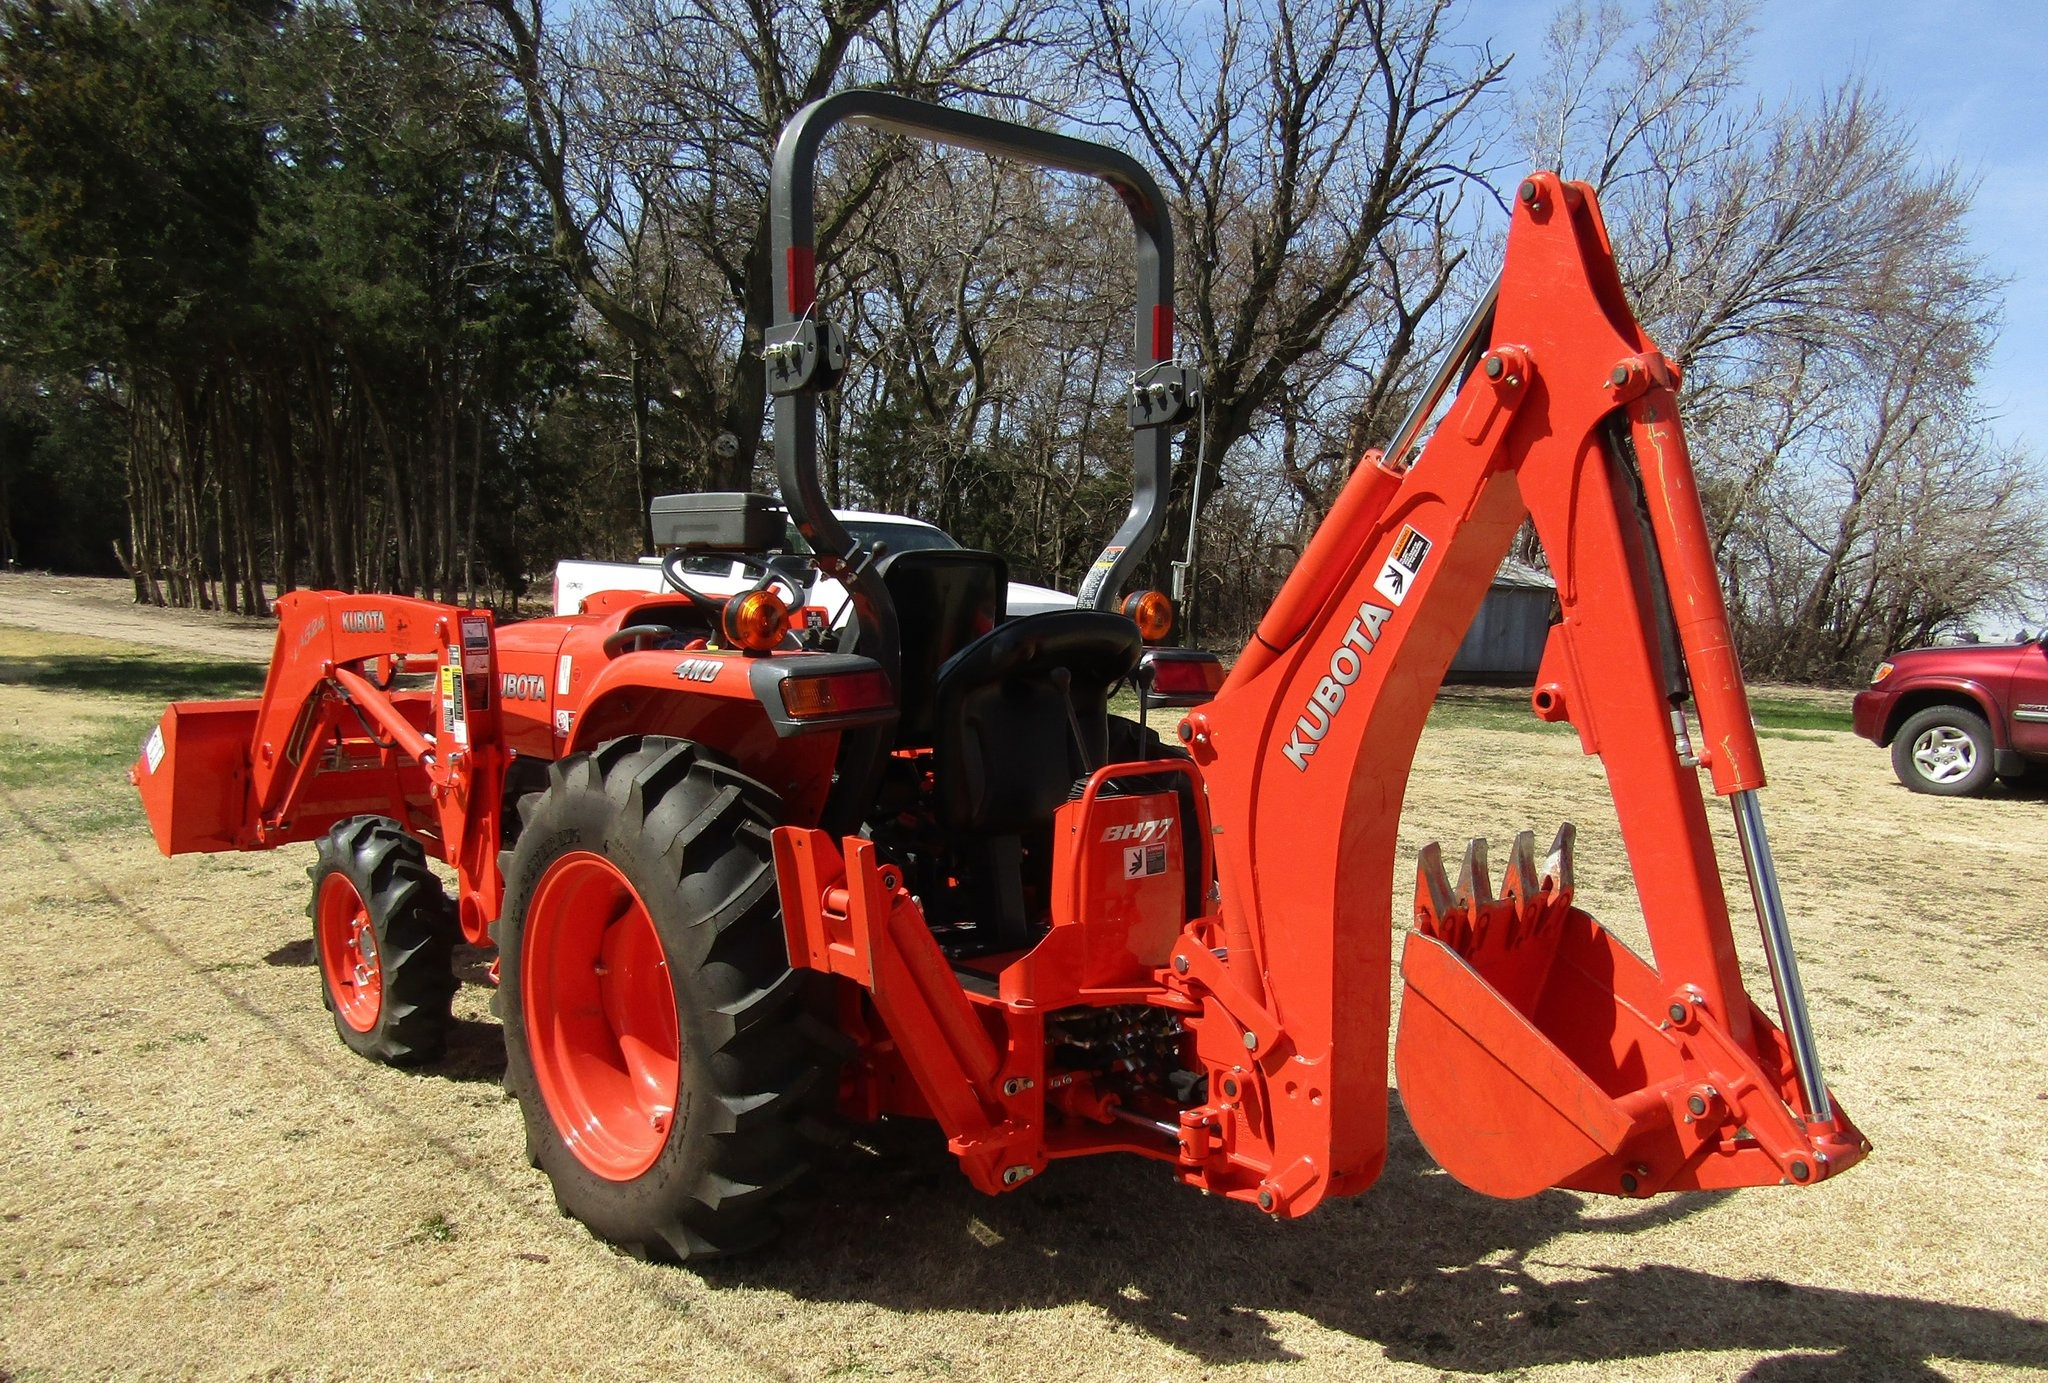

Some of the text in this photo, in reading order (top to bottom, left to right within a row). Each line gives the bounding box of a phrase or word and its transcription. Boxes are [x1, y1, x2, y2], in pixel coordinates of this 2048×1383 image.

[341, 610, 386, 633] KUBOTA
[672, 658, 724, 683] 4WD
[499, 671, 546, 702] UBOTA
[1281, 601, 1394, 772] KUBOTA
[1100, 817, 1175, 843] BH77
